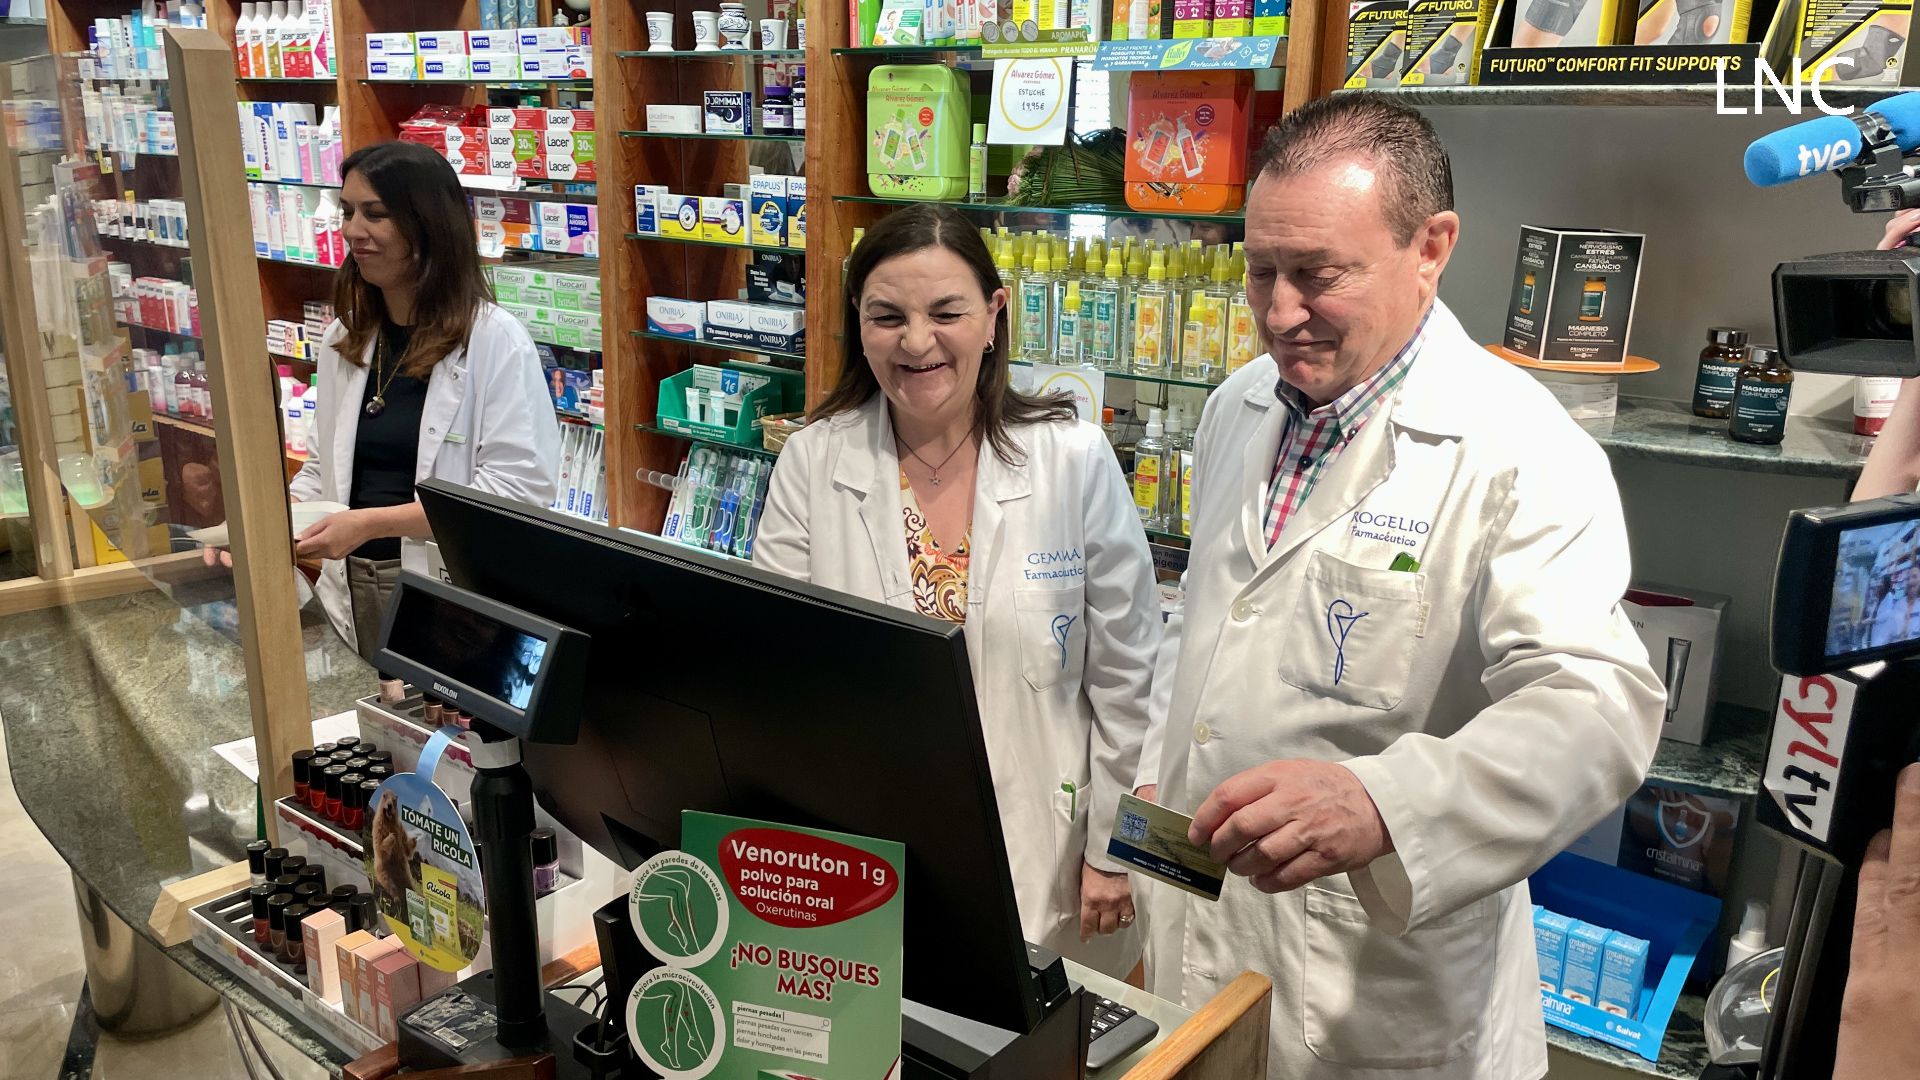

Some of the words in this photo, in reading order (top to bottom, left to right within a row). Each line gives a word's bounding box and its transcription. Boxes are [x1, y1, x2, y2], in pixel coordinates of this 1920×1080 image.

[1428, 1, 1472, 11] FUTURO
[1556, 57, 1627, 73] COMFORT
[1630, 57, 1654, 71] FIT
[1018, 88, 1046, 97] ESTUCHE
[1022, 102, 1045, 112] 19,95€
[492, 113, 511, 123] Lacer
[550, 114, 570, 125] Lacer
[490, 134, 511, 146] Lacer
[547, 137, 570, 148] Lacer
[492, 159, 512, 169] Lacer
[1798, 140, 1852, 177] tve
[550, 161, 571, 172] Lacer
[481, 208, 496, 216] Lacer
[544, 214, 560, 222] Lacer
[546, 234, 562, 245] Lacer
[762, 254, 783, 264] ONIRIA
[496, 271, 526, 284] Fluocaril
[556, 278, 587, 290] Fluocaril
[659, 306, 686, 318] ONIRIA
[716, 311, 744, 324] ONIRIA
[558, 314, 589, 327] Fluocaril
[758, 316, 788, 330] ONIRIA
[759, 334, 788, 347] ONIRIA
[1702, 364, 1740, 373] MAGNESIO
[1702, 369, 1734, 377] COMPLETO
[725, 379, 736, 393] 1€
[1742, 385, 1784, 394] MAGNESIO
[1741, 390, 1778, 399] COMPLETO
[584, 494, 592, 517] VITIS
[670, 515, 679, 536] VITIS
[1351, 511, 1429, 535] ROGELIO
[1351, 526, 1416, 547] Farmacéutico
[1024, 567, 1085, 580] Farmacutic
[402, 807, 442, 836] TÓMATE
[445, 827, 459, 845] UN
[433, 838, 472, 867] RICOLA
[731, 839, 850, 877] Venoruton
[1646, 847, 1701, 872] cristalmina
[631, 869, 650, 904] Fortalece
[650, 861, 660, 871] las
[660, 855, 689, 868] paredes
[689, 860, 699, 870] de
[699, 867, 709, 879] las
[709, 878, 721, 902] venas
[740, 867, 782, 886] polvo
[785, 875, 820, 892] para
[426, 882, 451, 900] Ricola
[740, 884, 801, 905] solución
[805, 895, 834, 910] oral
[756, 902, 817, 922] Oxerutinas
[730, 941, 773, 970] ¡NO
[777, 949, 880, 987] BUSQUES
[632, 978, 653, 1001] Mejora
[653, 973, 661, 981] la
[662, 970, 716, 1010] microcirculación
[777, 971, 833, 1002] MÁS!
[737, 1005, 758, 1014] piernas
[759, 1009, 782, 1018] pesadas
[737, 1019, 757, 1027] piernas
[758, 1023, 780, 1033] pesadas
[793, 1030, 813, 1038] varices
[737, 1028, 756, 1036] piernas
[758, 1031, 786, 1042] hinchadas
[1616, 1025, 1642, 1040] Salvat
[756, 1040, 785, 1052] hormigueo
[794, 1047, 802, 1055] las
[803, 1051, 823, 1059] piernas
